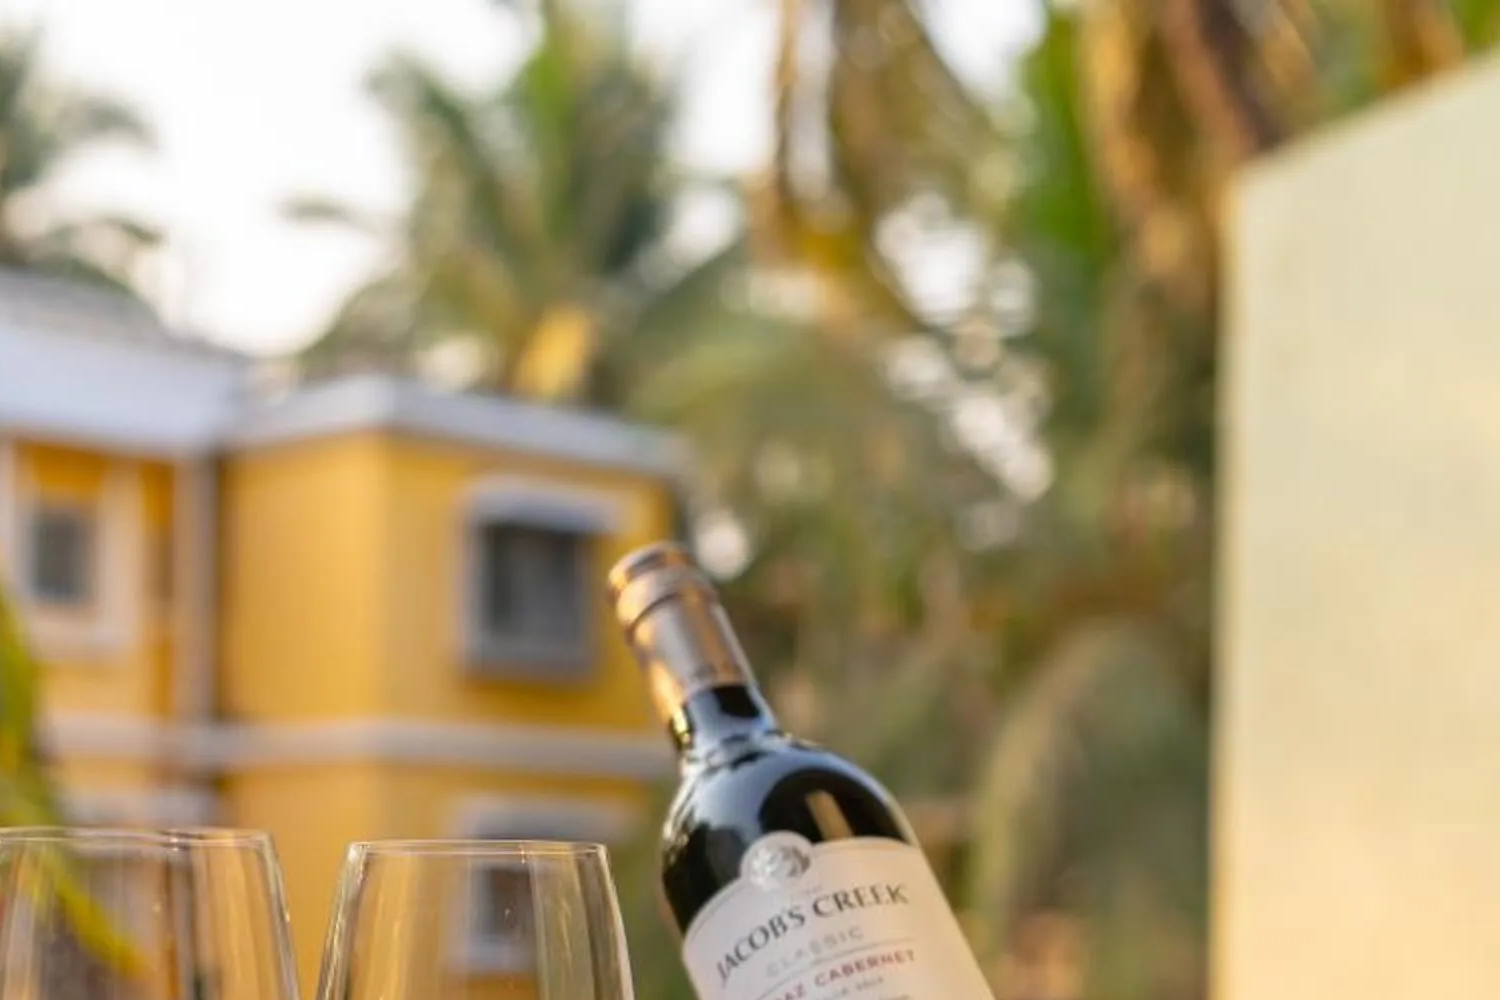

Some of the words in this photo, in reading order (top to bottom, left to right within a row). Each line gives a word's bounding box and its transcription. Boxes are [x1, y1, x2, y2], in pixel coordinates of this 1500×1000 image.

[717, 904, 806, 989] JACOB'S
[812, 884, 909, 918] CREEK
[766, 926, 865, 976] CLASSIC
[814, 949, 916, 987] CABERNET
